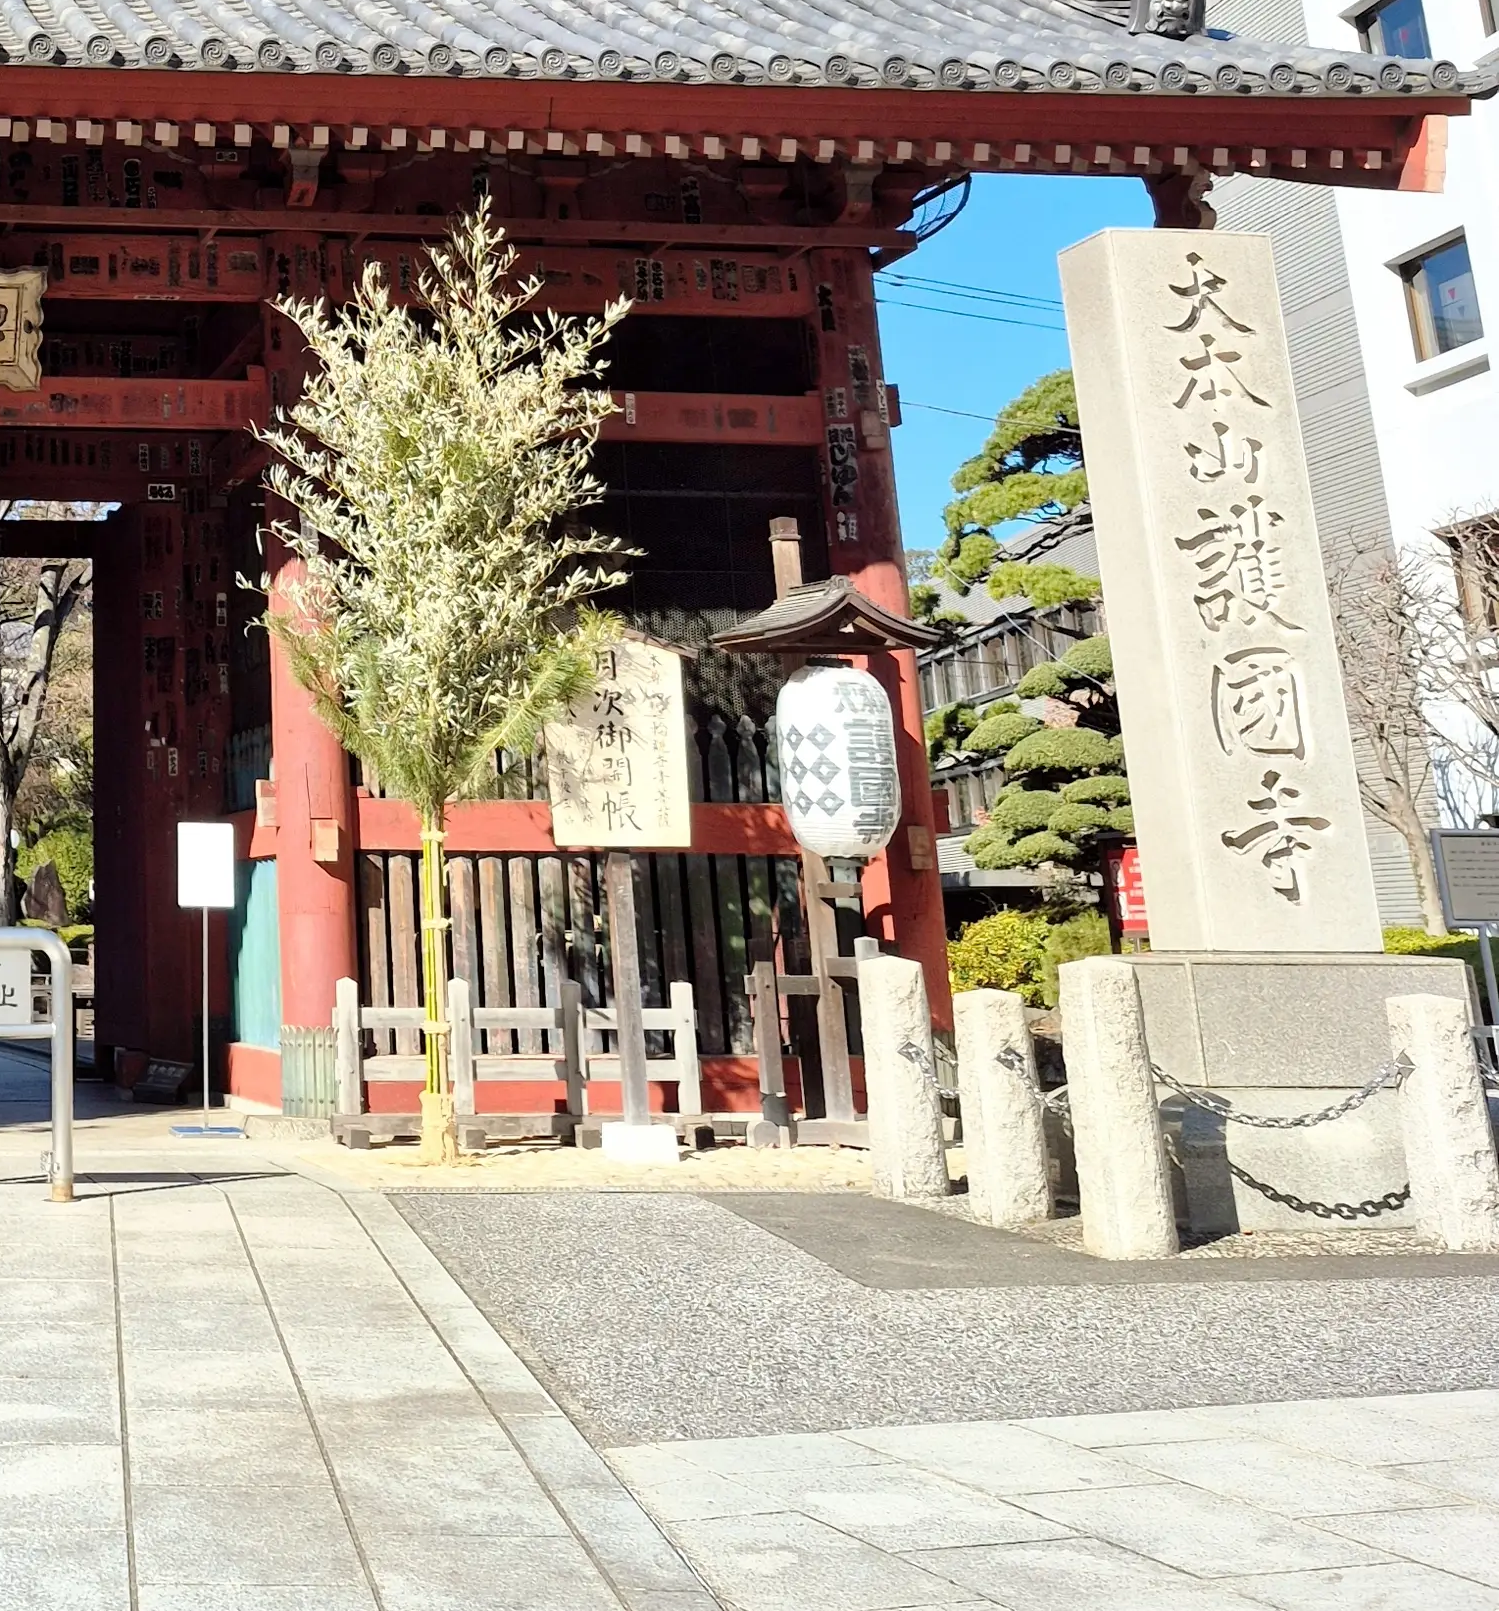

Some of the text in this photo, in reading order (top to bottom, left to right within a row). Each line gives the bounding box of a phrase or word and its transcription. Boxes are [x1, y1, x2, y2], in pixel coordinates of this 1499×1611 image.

[1163, 251, 1332, 906] 大本山護國寺
